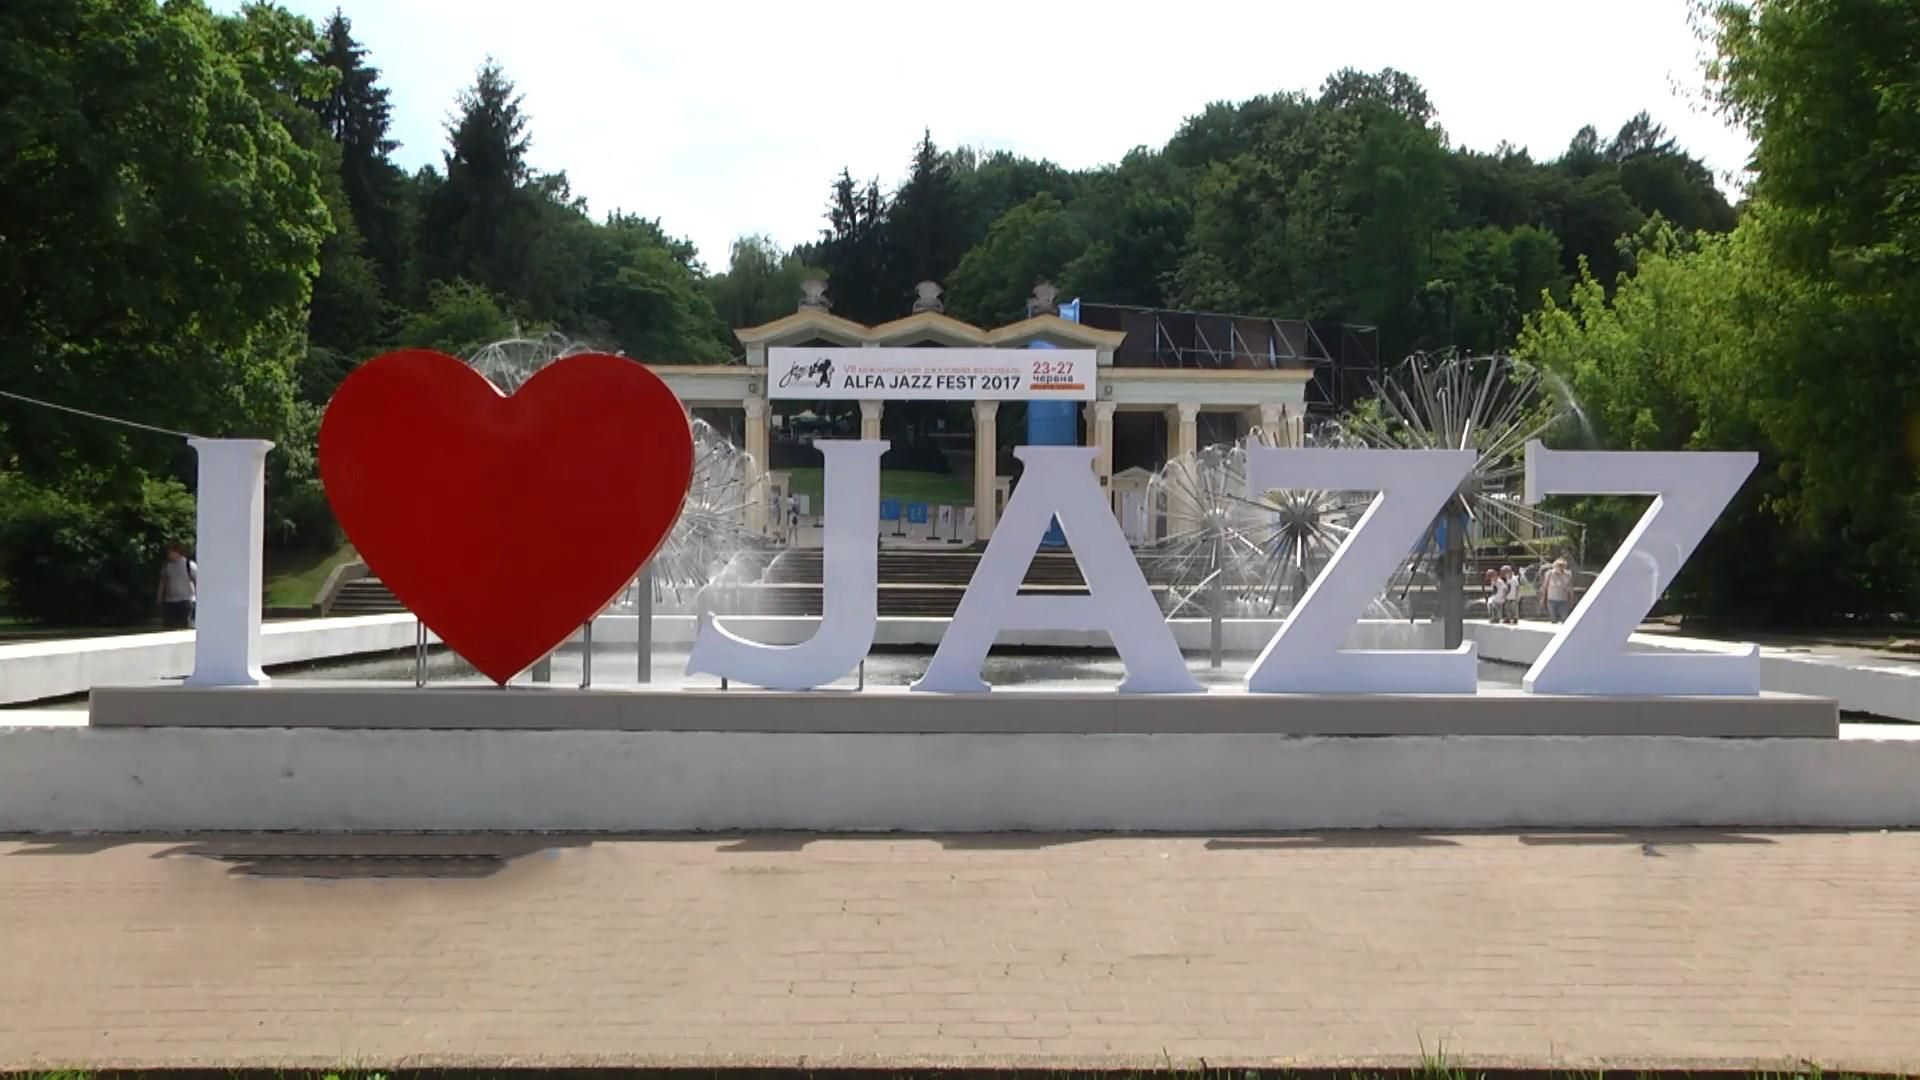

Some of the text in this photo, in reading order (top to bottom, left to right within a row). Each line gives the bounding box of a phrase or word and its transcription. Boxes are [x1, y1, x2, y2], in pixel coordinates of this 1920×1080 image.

[1032, 361, 1074, 375] 23-27
[843, 375, 885, 389] ALFA
[889, 375, 932, 389] JAZZ
[936, 375, 977, 390] FEST
[980, 375, 1021, 390] 2017
[185, 437, 1761, 695] I JAZZ
